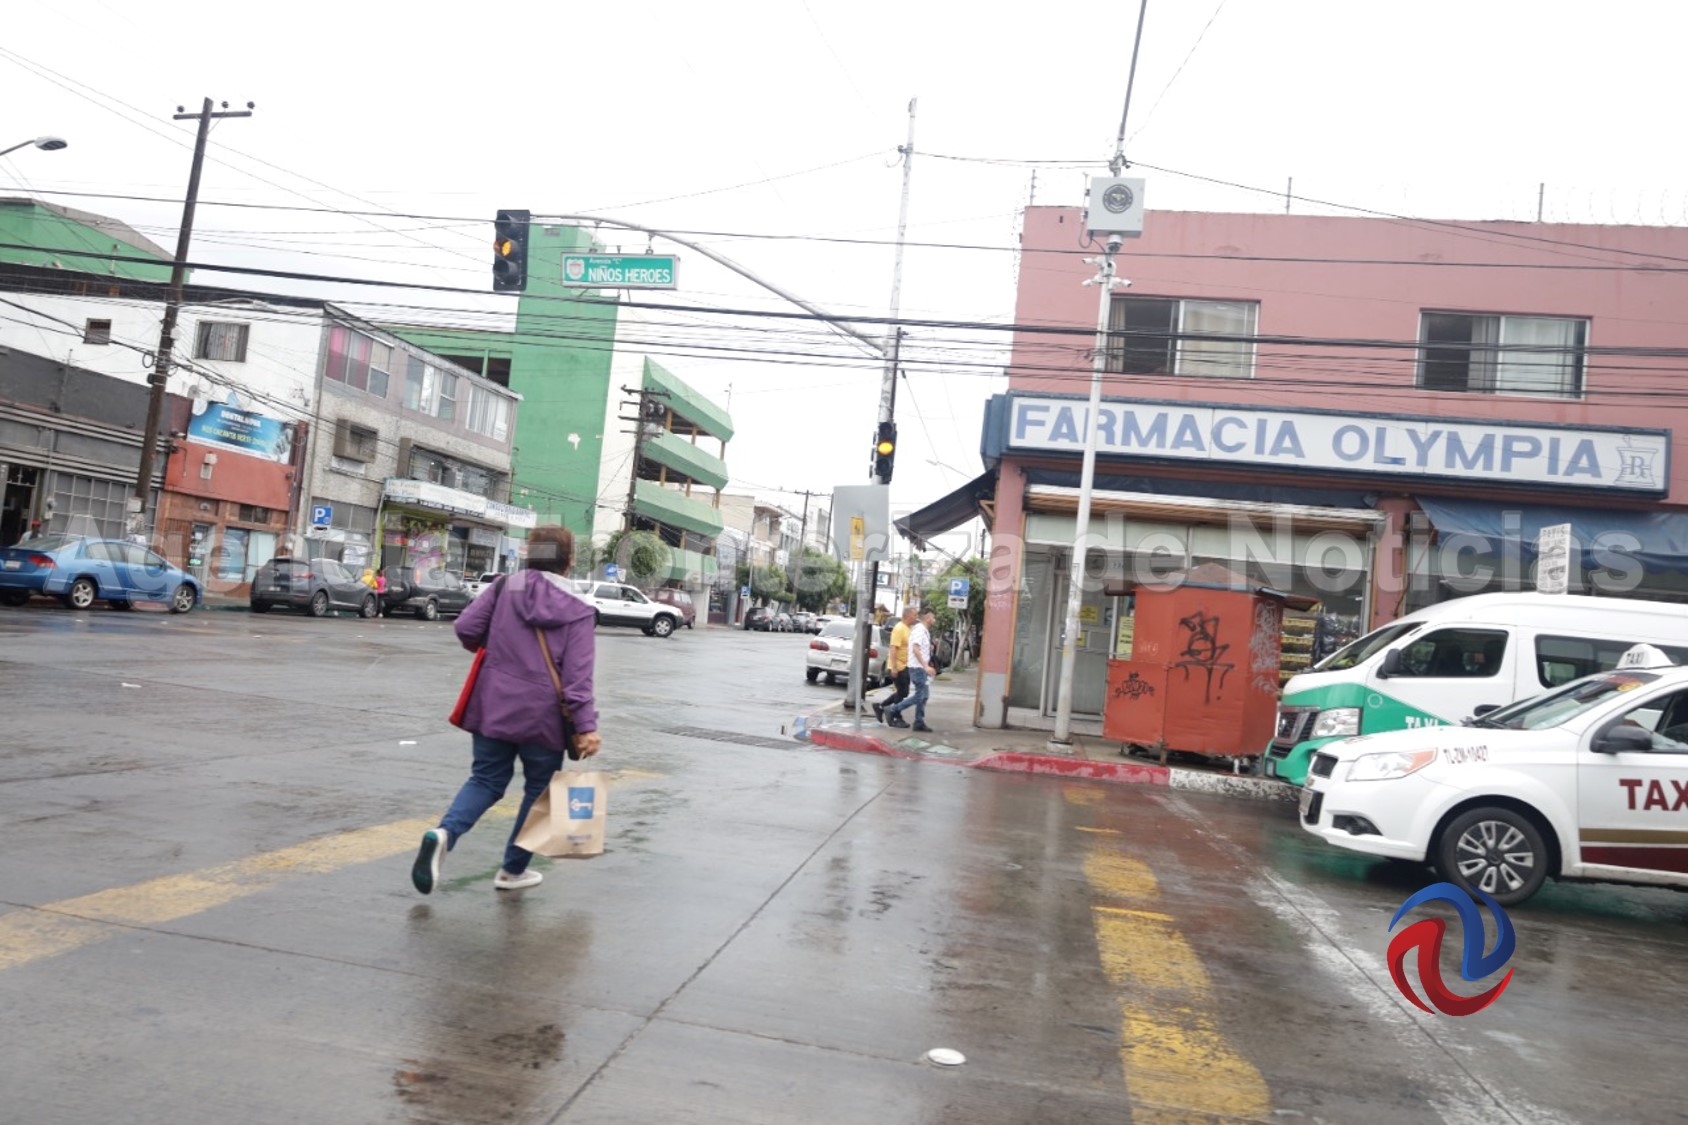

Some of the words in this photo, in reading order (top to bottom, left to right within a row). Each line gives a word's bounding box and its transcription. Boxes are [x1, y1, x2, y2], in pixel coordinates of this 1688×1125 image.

[588, 265, 622, 282] NIÑOS
[624, 268, 671, 283] HEROES
[1015, 404, 1306, 459] FARMACIA
[1332, 424, 1602, 479] OLYMPIA
[314, 507, 326, 522] P
[951, 580, 963, 592] P
[1625, 651, 1645, 665] TAXI
